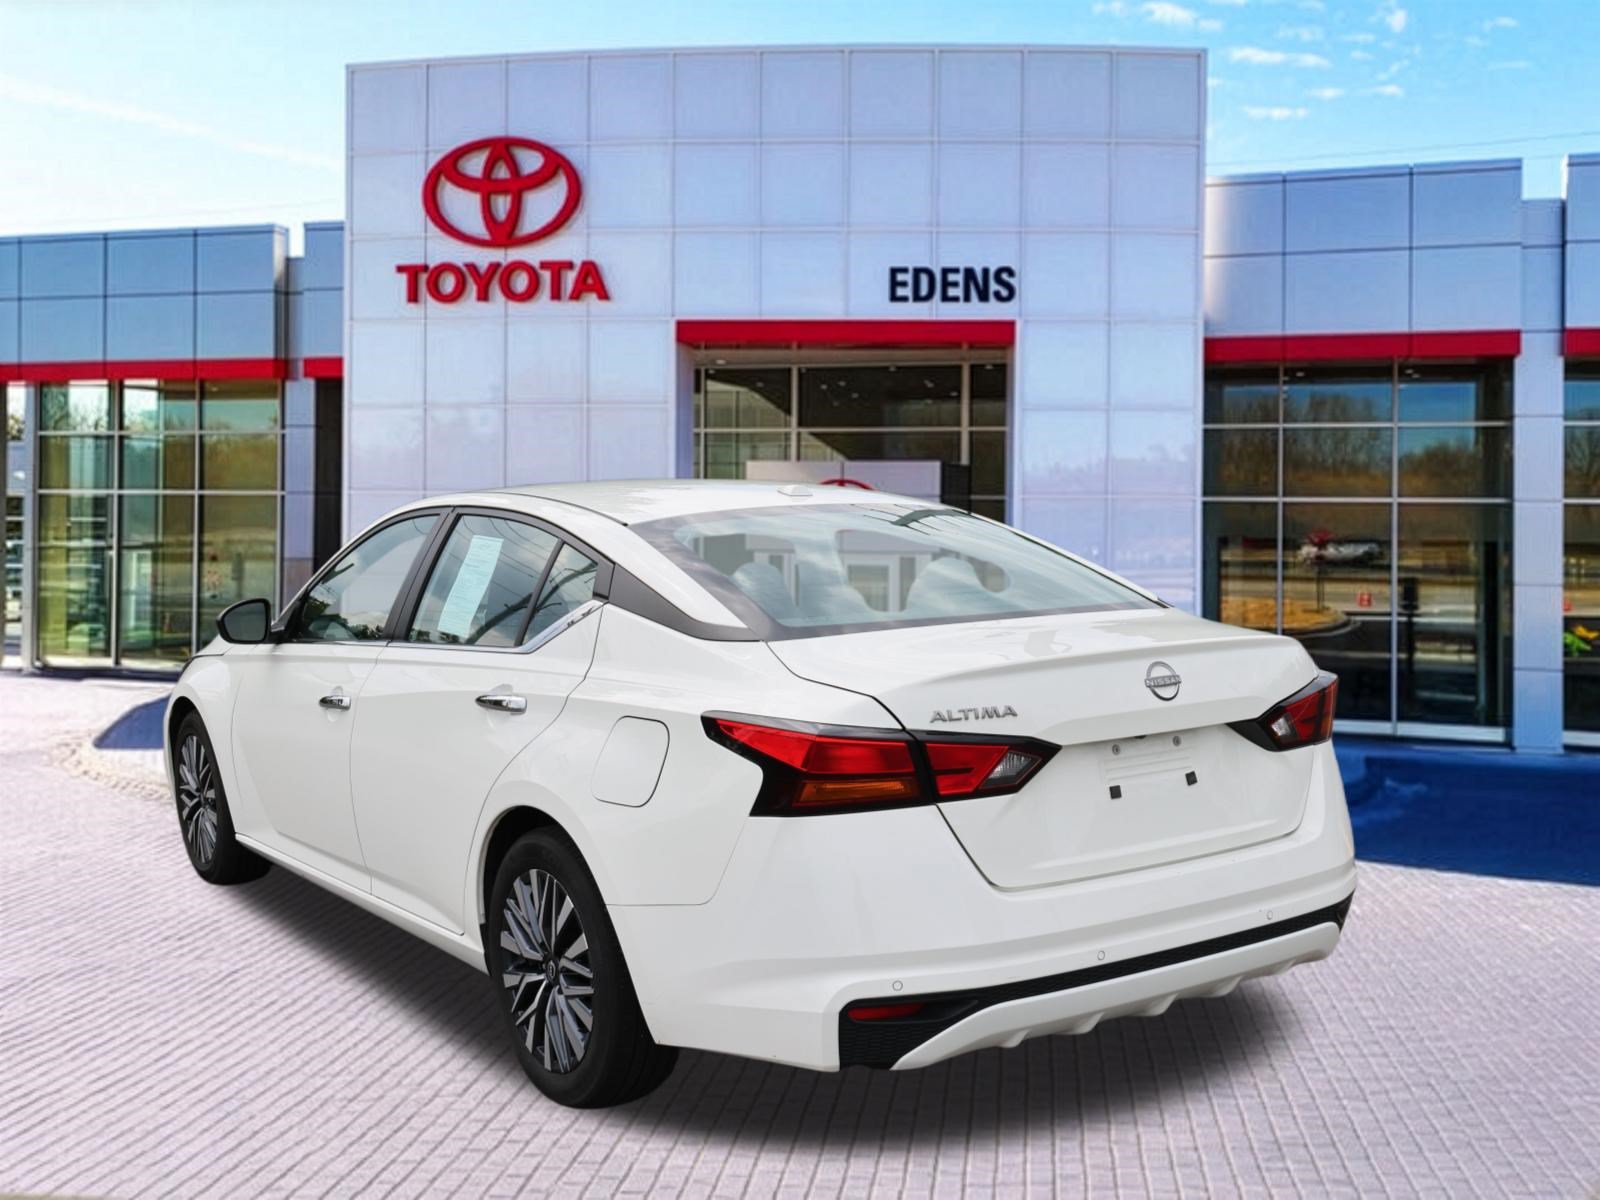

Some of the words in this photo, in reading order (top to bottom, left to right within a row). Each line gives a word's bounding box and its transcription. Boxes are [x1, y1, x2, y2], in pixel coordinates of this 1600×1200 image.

[396, 259, 610, 304] TOYOTA
[889, 266, 1017, 304] EDENS
[1144, 675, 1181, 688] NISSAN
[929, 705, 1018, 723] ALTIMA
